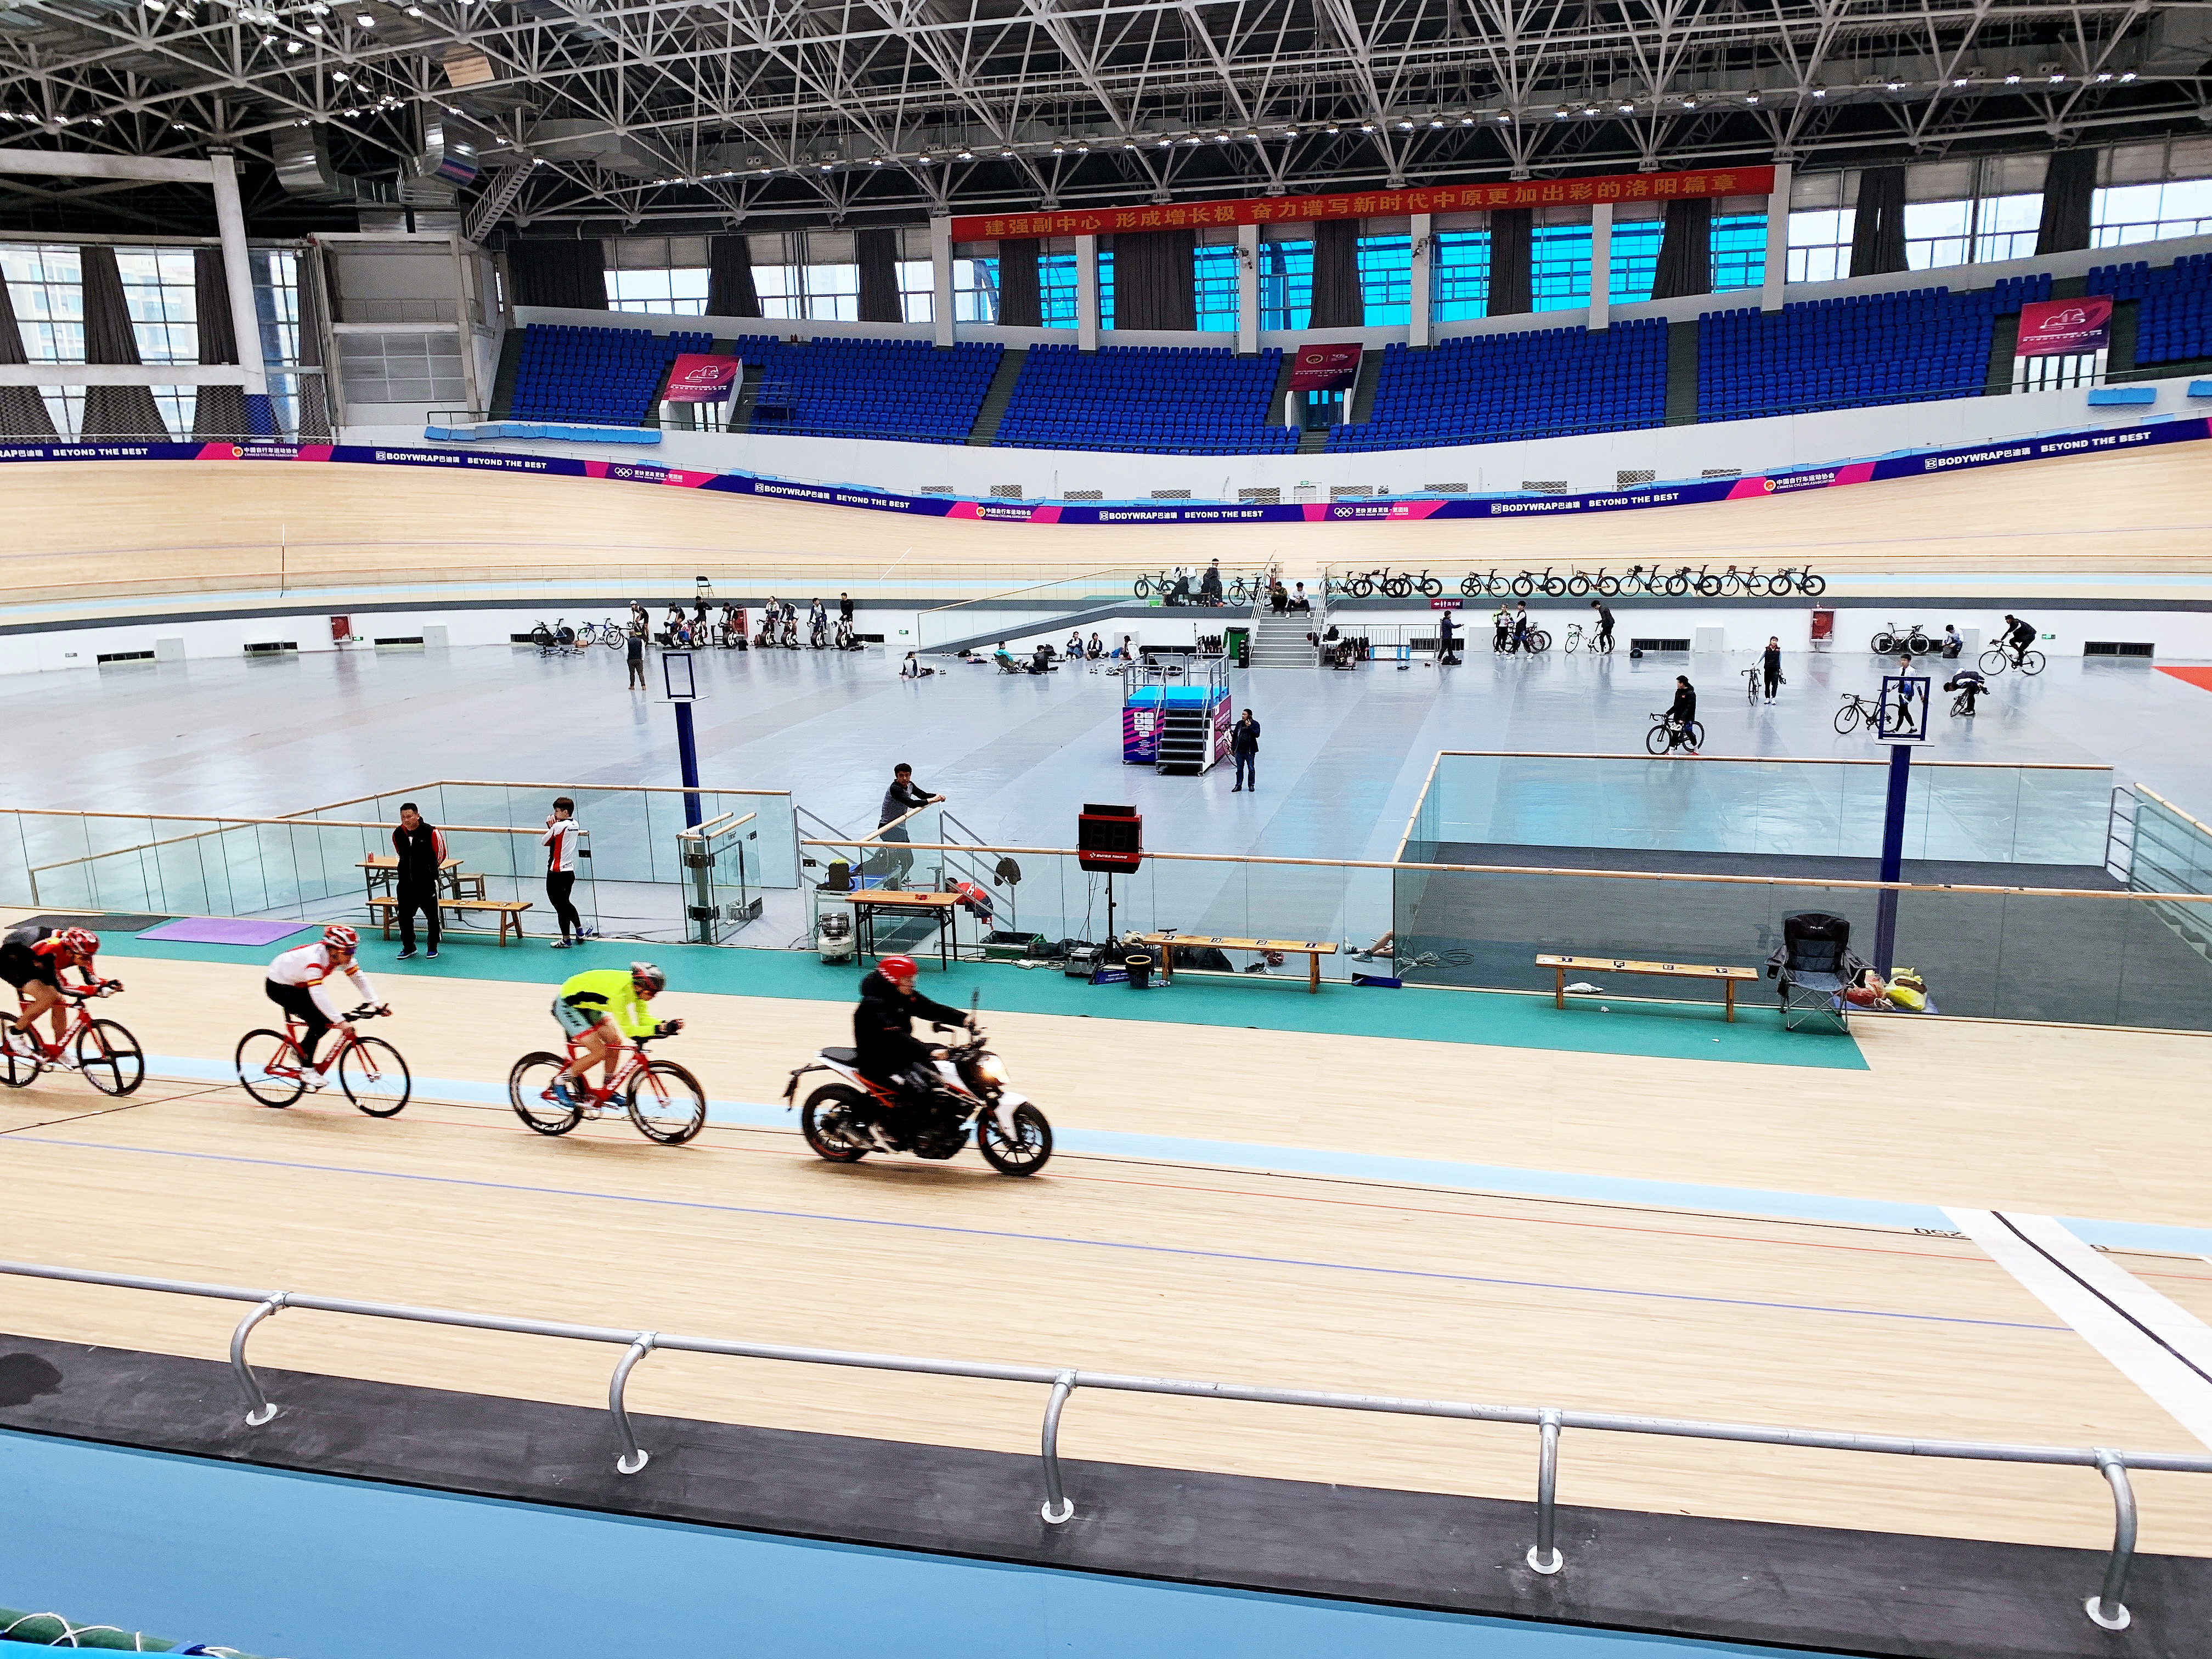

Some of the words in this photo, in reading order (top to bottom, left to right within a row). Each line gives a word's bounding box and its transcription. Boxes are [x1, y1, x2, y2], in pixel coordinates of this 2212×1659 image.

[985, 216, 1101, 235] 建强副中心
[1116, 206, 1235, 227] 形成增长极
[1251, 174, 1737, 220] 奋力谱写新时代中原更加出彩的洛阳篇章
[2040, 439, 2089, 453] BEYOND
[2091, 436, 2116, 446] THE
[2119, 431, 2151, 443] BEST
[53, 448, 96, 456] BEYOND
[98, 448, 120, 456] THE
[467, 457, 503, 466] BEYOND
[525, 461, 547, 469] BEST
[1776, 472, 1835, 486] 中国自行车运动协会
[837, 494, 869, 504] BEYOND
[871, 498, 887, 506] THE
[889, 500, 910, 509] BEST
[1589, 498, 1628, 507] BEYOND
[1630, 495, 1651, 504] THE
[1654, 493, 1679, 502] BEST
[986, 507, 1031, 516] 中国自行车运动协会
